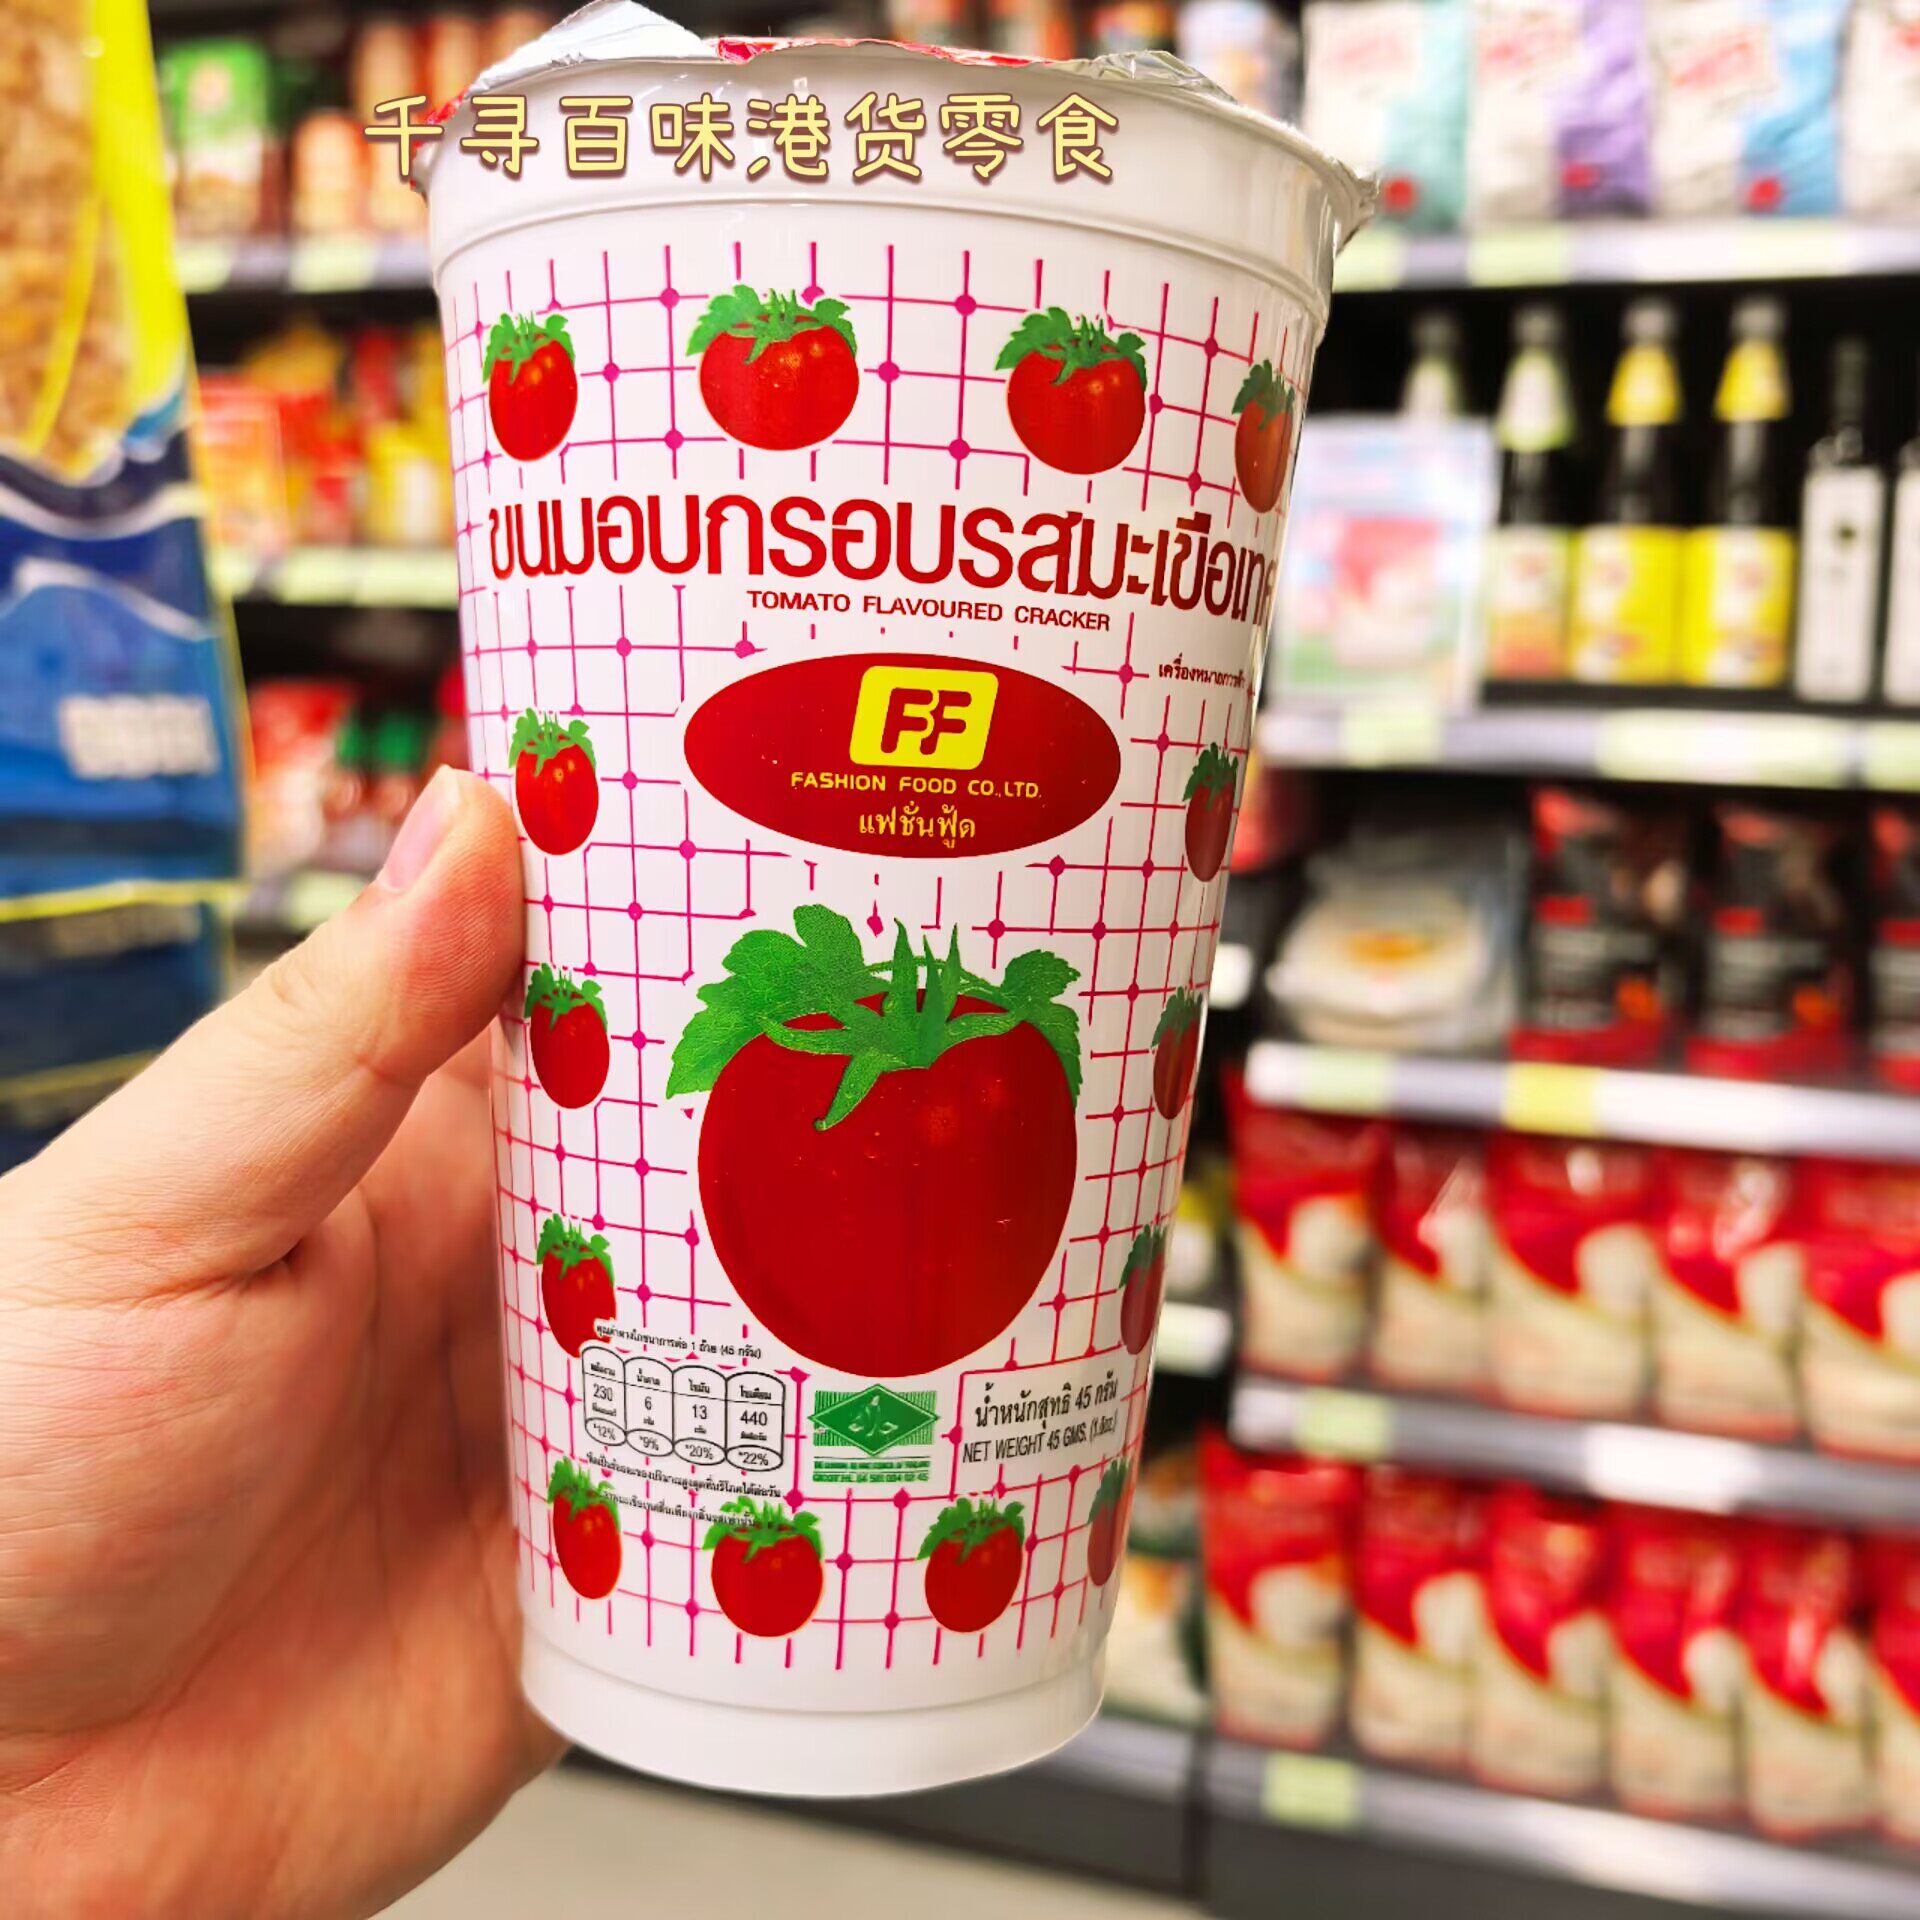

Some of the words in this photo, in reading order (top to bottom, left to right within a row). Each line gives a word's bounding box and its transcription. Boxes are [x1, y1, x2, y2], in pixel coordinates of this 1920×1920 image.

[746, 590, 851, 613] TOMATO
[862, 595, 1003, 622] FLAVOURED
[1014, 605, 1111, 631] CRACKER
[791, 771, 886, 791] FASHION
[899, 776, 957, 794] FOOD
[593, 1383, 613, 1402] 230
[644, 1396, 652, 1411] 6
[692, 1404, 708, 1420] 13
[975, 1382, 1073, 1429] น้ำหนักสุทธิ
[1075, 1384, 1094, 1411] 45
[740, 1409, 768, 1427] 440
[962, 1440, 992, 1464] NET
[995, 1432, 1046, 1460] WEIGHT
[1046, 1429, 1061, 1451] 45
